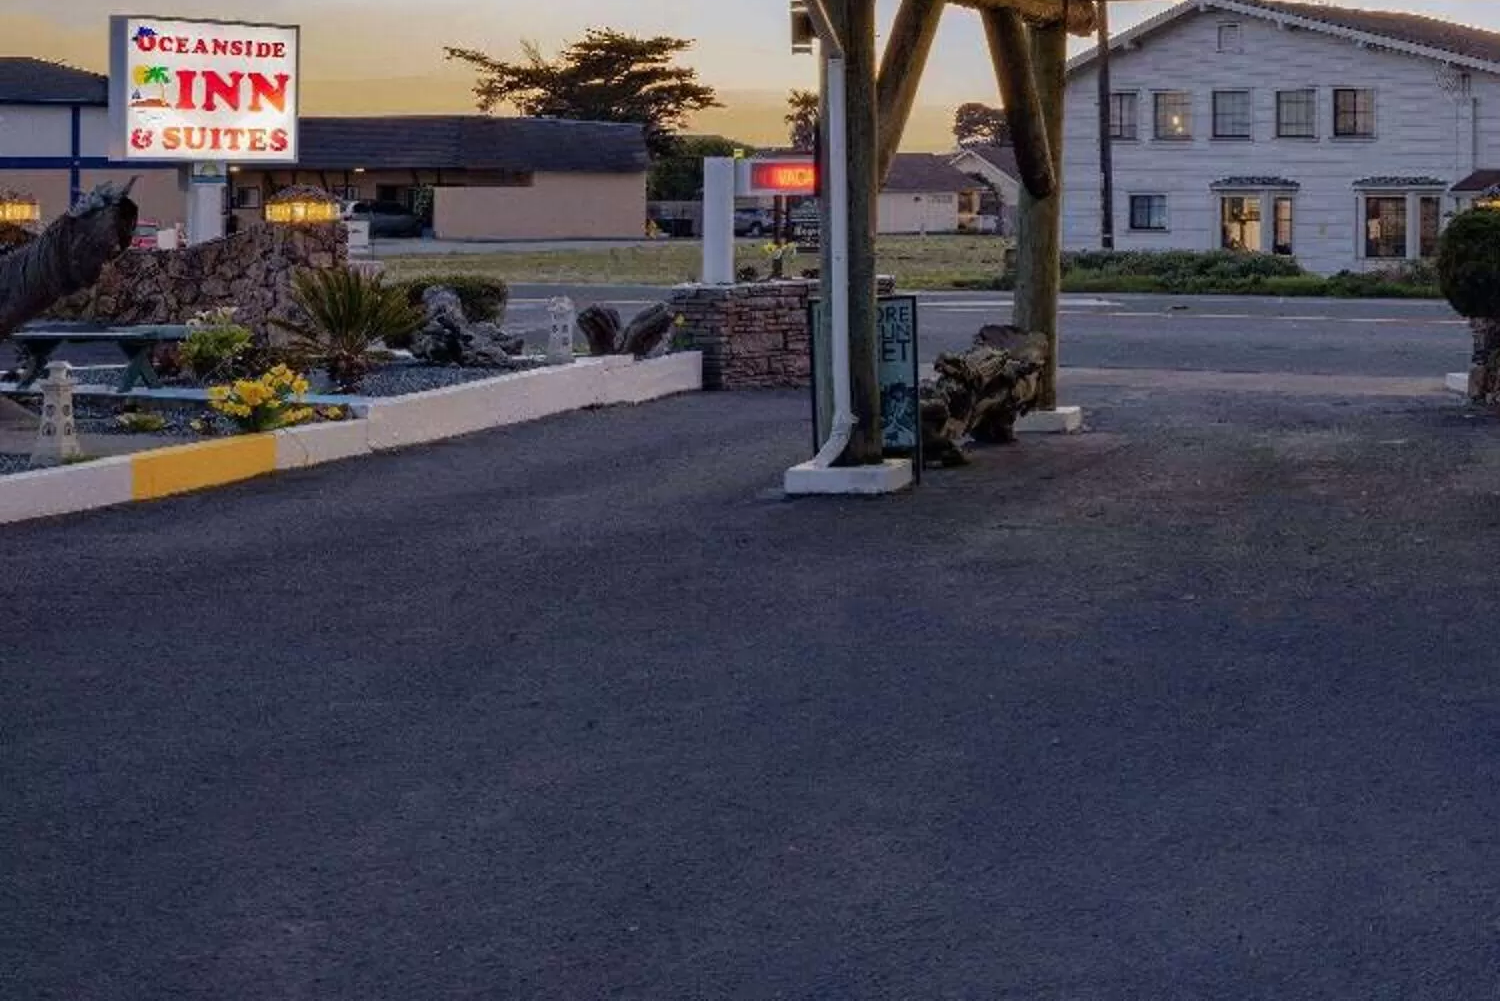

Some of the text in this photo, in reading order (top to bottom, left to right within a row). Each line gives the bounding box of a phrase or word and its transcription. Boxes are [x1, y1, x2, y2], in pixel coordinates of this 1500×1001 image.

[137, 35, 286, 59] OCEANSIDE
[175, 70, 290, 113] INN
[131, 126, 289, 152] & SUITES
